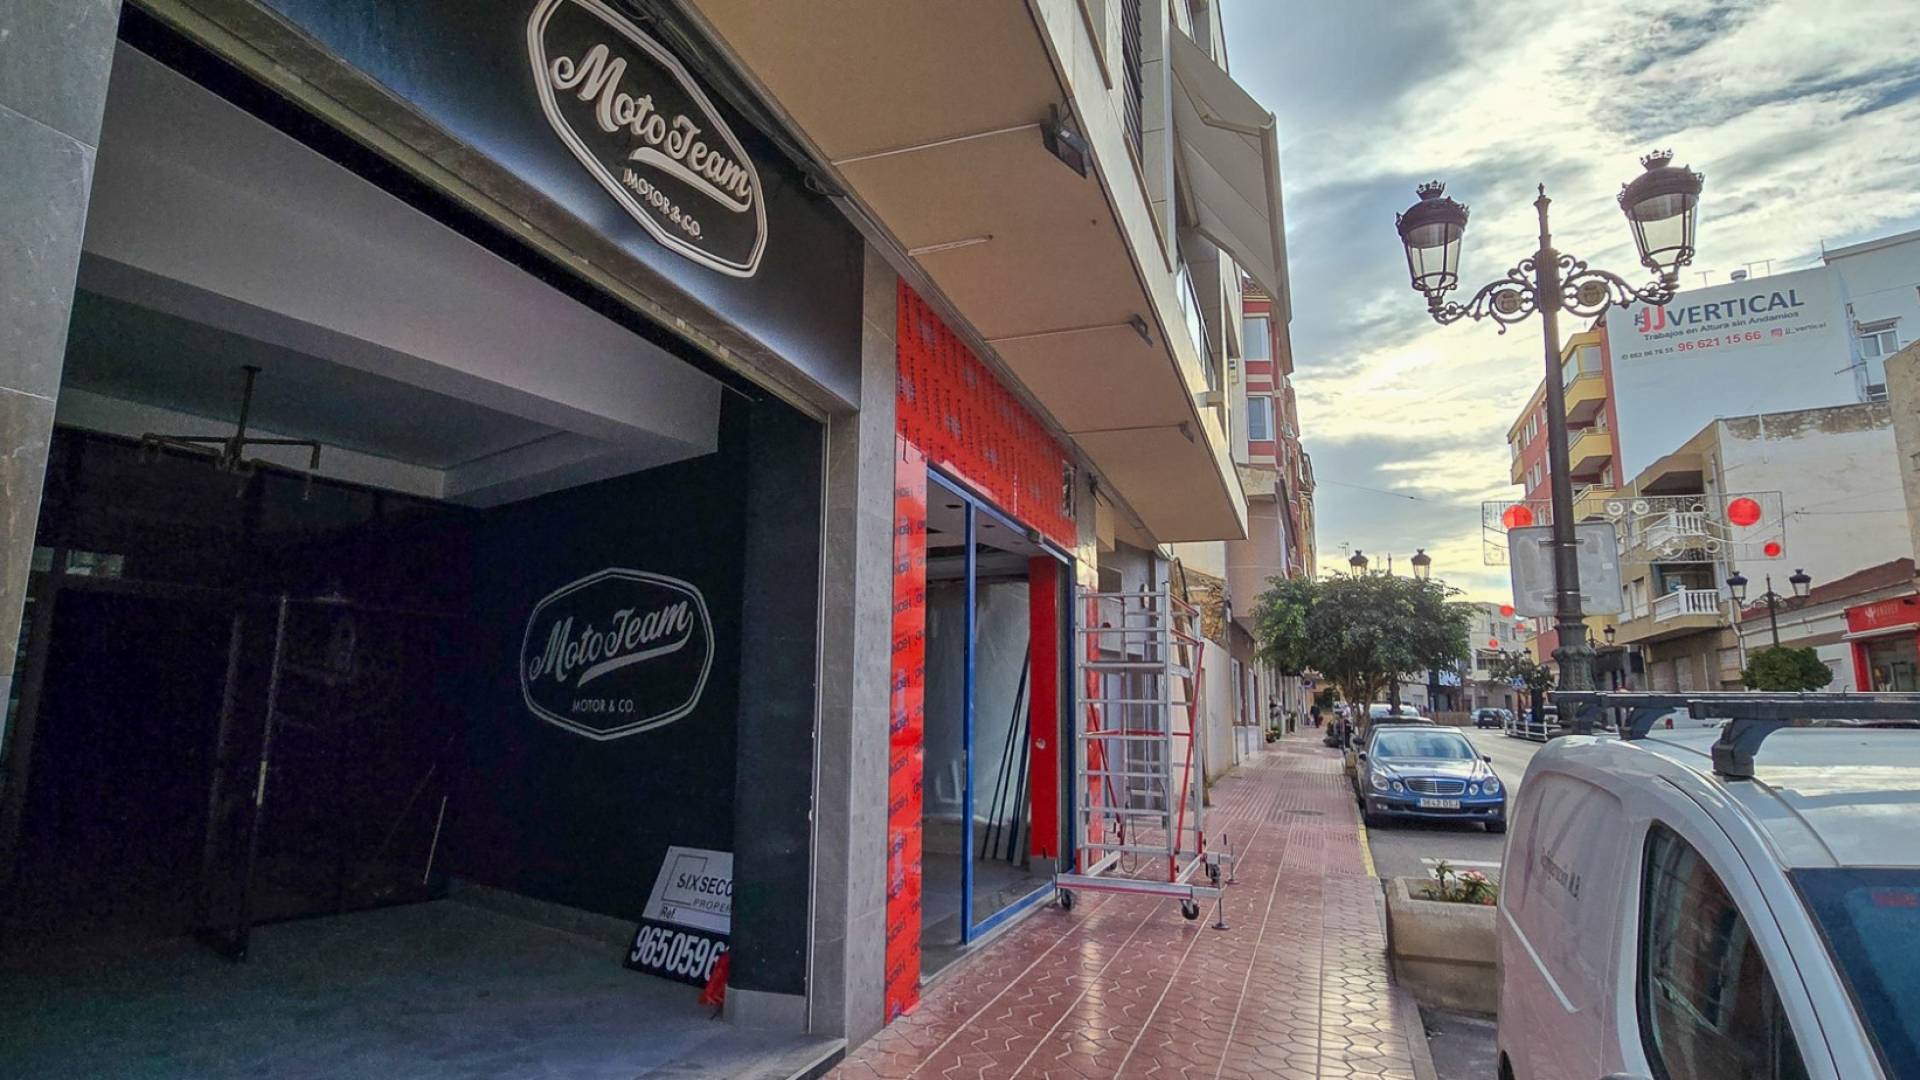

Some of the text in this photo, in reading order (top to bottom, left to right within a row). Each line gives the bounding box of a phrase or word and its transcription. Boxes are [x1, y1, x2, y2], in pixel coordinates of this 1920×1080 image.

[623, 168, 670, 215] MOTOR
[1644, 311, 1800, 342] Trabajos en Altura sin Andamios
[1678, 341, 1694, 352] 96
[1697, 337, 1720, 348] 621
[1725, 333, 1741, 344] 15
[1744, 331, 1761, 341] 66
[572, 699, 605, 712] MOTOR
[608, 699, 615, 712] &
